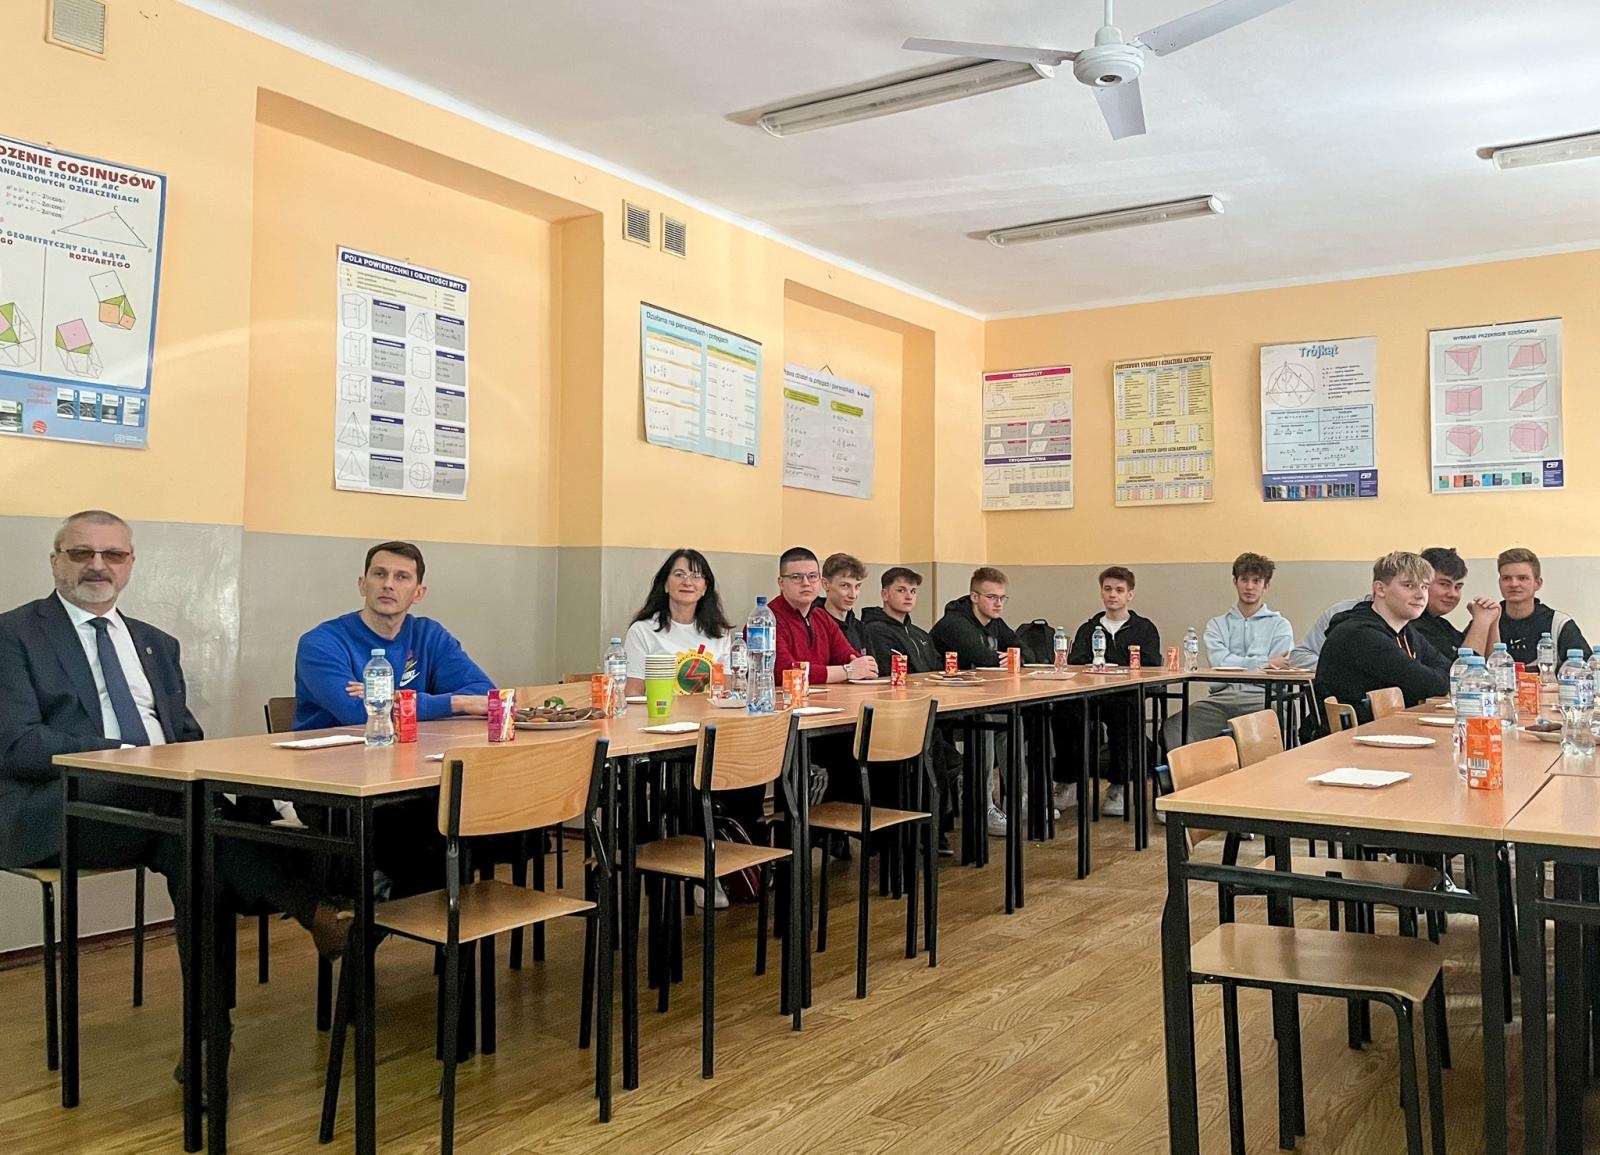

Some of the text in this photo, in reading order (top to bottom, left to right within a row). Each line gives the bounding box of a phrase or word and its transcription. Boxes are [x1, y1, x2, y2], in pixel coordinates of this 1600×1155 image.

[1, 158, 46, 175] OWOLNYM
[101, 183, 120, 191] ABC
[57, 160, 156, 190] COSINUSÓW
[69, 184, 139, 203] OZNACZENIACH
[6, 230, 126, 260] GEOMETRYCZNY DLA KĄTA
[69, 252, 131, 268] ROZWARTEGO
[344, 253, 362, 264] POLA
[364, 259, 410, 276] POWIERZCHNI
[1299, 344, 1339, 359] Trójkąt
